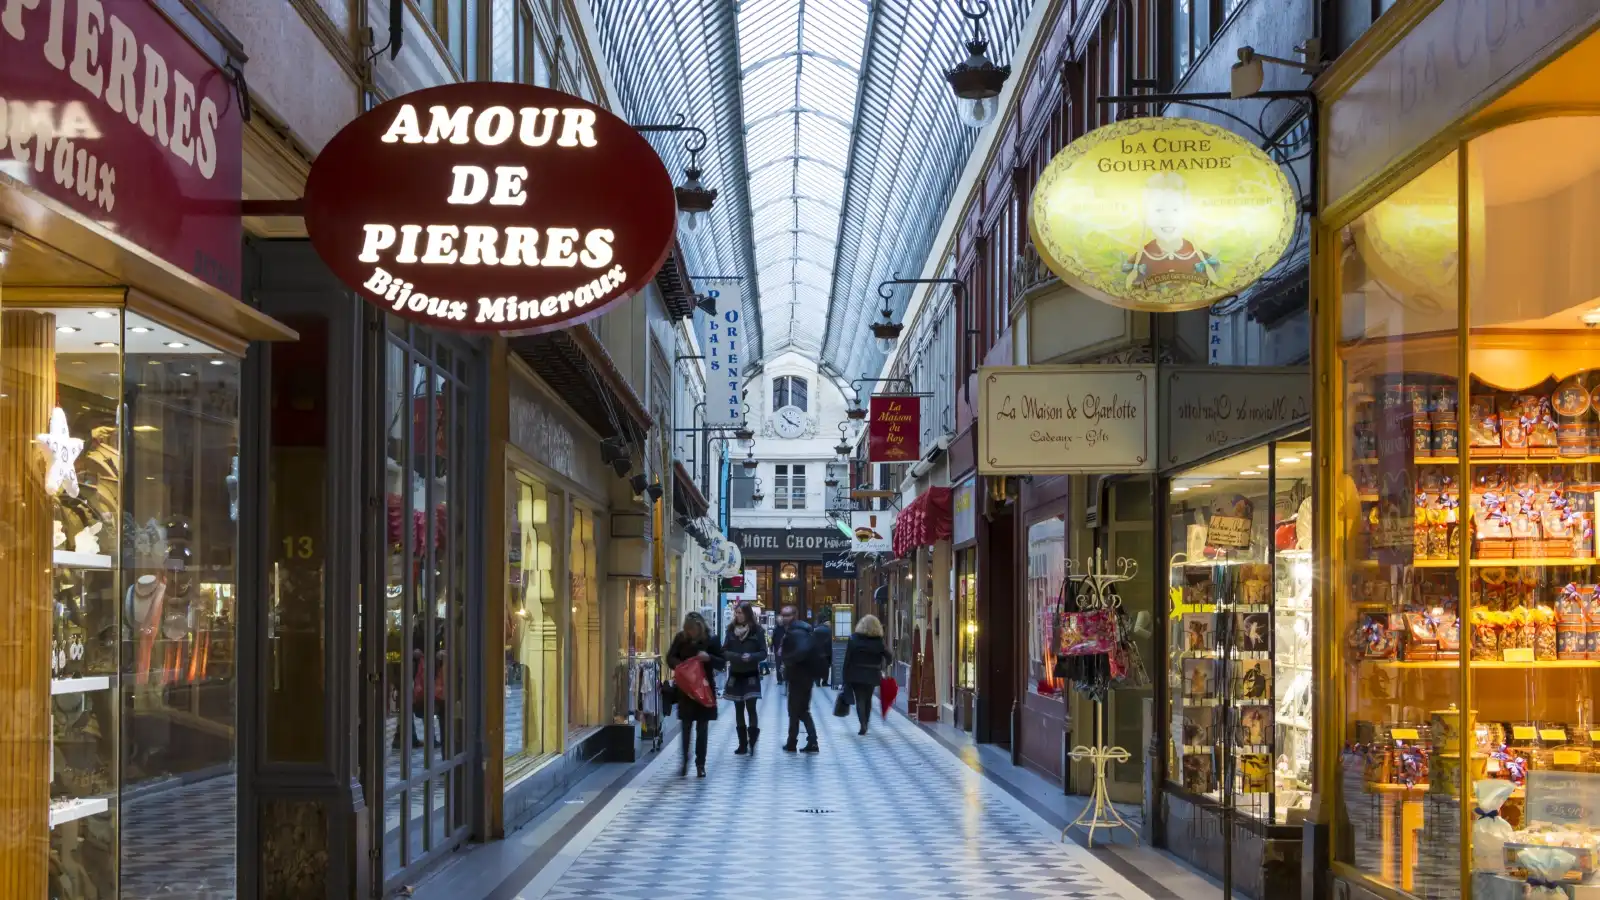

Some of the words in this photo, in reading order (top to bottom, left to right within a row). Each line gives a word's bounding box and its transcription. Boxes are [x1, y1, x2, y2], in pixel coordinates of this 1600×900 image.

[381, 104, 598, 148] AMOUR
[1121, 139, 1146, 154] LA
[1153, 138, 1211, 154] CURE
[1098, 157, 1232, 173] GOURMANDE
[447, 165, 529, 206] DE
[358, 224, 615, 269] PIERRES
[363, 267, 468, 322] Bijoux
[475, 264, 627, 324] Mineraux
[708, 289, 720, 371] PLAIS
[724, 310, 739, 418] ORIENTAL
[878, 411, 912, 422] Maison
[888, 401, 902, 411] La
[996, 396, 1016, 420] La
[1021, 396, 1063, 420] Maison
[1066, 395, 1077, 420] de
[1082, 394, 1137, 425] Charlotte
[886, 432, 904, 444] Roy
[1030, 430, 1073, 450] Cadeaux
[282, 535, 313, 559] 13
[743, 534, 779, 549] HÔTEL
